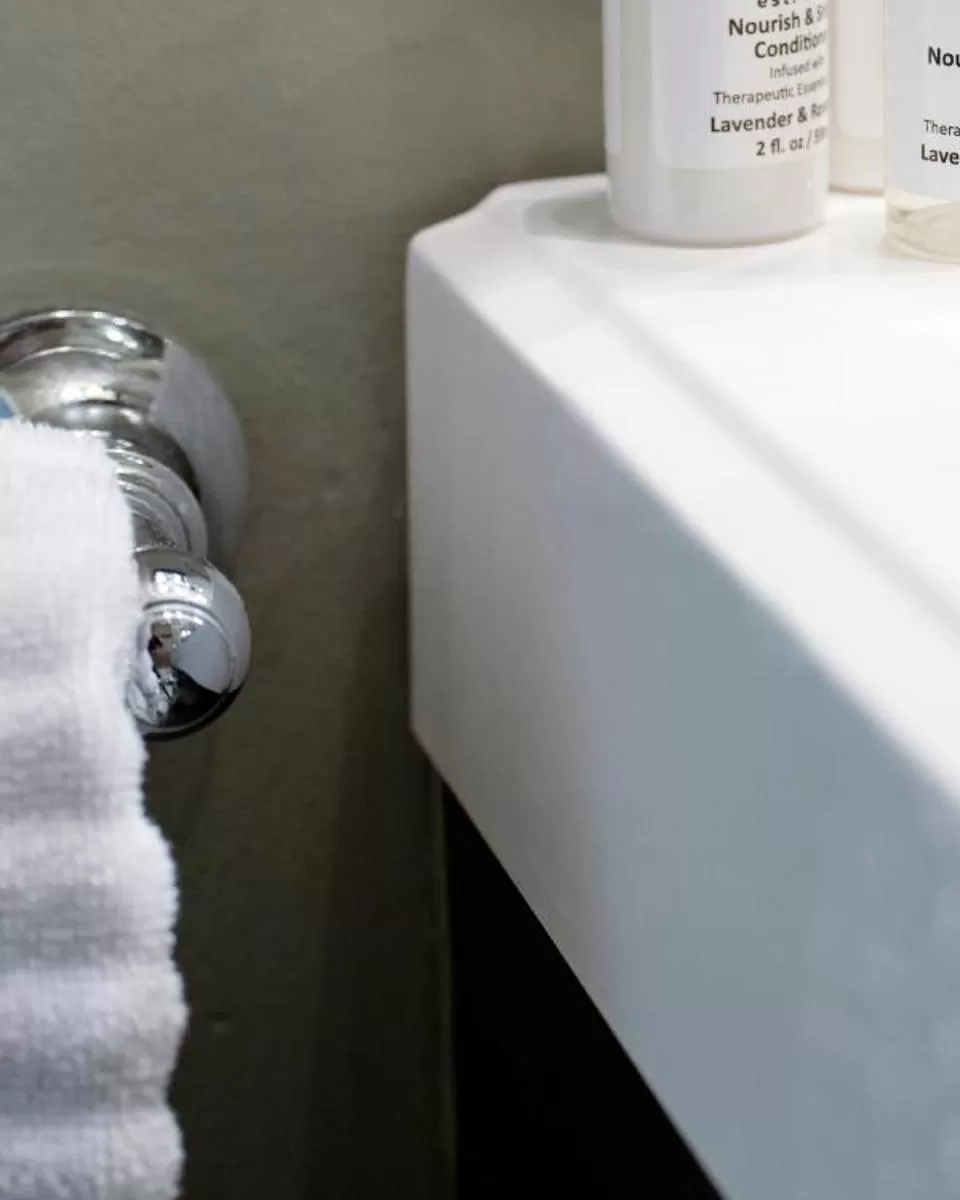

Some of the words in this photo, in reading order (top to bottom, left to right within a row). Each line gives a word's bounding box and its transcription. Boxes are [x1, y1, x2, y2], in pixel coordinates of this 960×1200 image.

[728, 11, 801, 37] Nourish
[804, 7, 814, 26] &
[769, 58, 811, 79] Infused
[712, 84, 795, 105] Therapeutic
[710, 111, 794, 132] Lavender
[797, 106, 807, 123] &
[756, 141, 766, 156] 2
[770, 137, 785, 155] fl.
